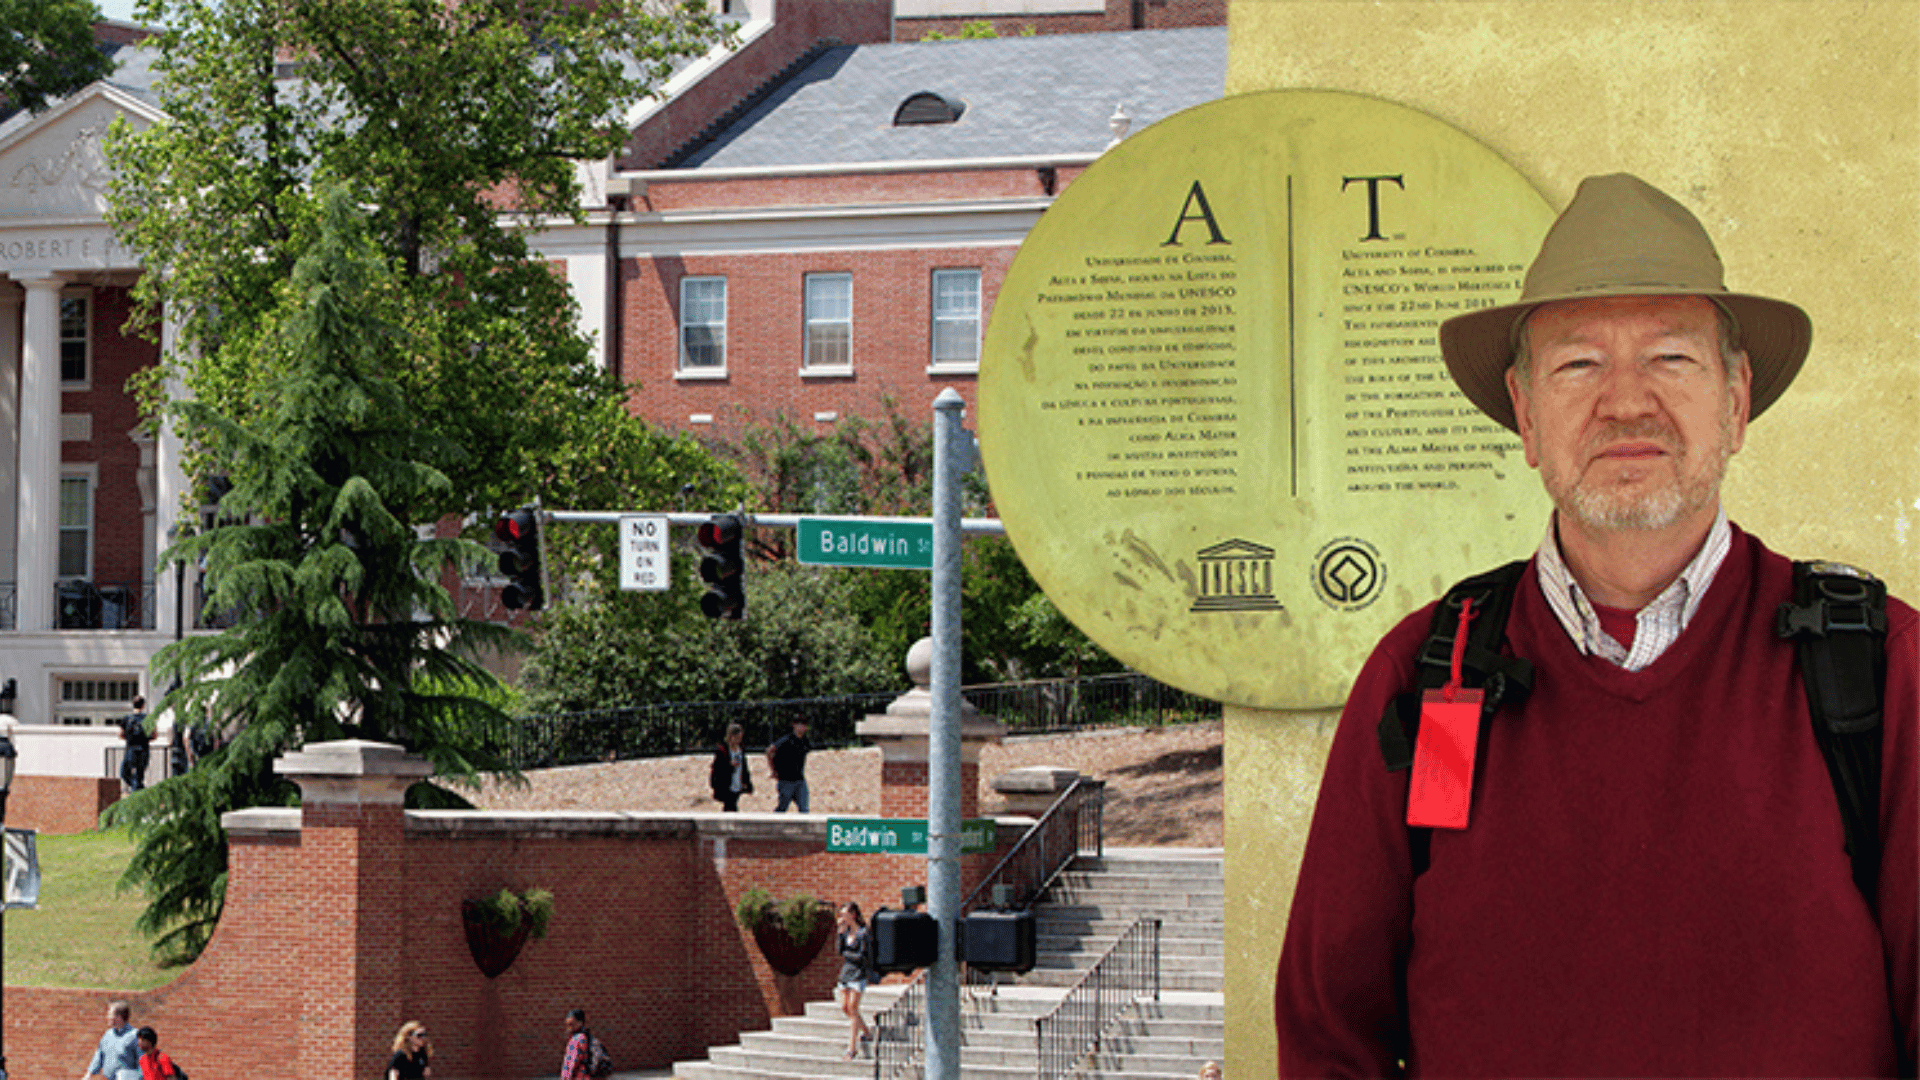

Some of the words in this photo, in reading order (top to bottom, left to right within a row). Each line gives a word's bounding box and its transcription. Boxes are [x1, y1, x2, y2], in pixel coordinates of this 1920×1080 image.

[1160, 179, 1232, 247] A
[1341, 173, 1405, 243] T
[1110, 308, 1125, 320] 22
[632, 522, 657, 538] NO
[630, 541, 660, 552] TURN
[820, 529, 909, 557] Baldwin
[635, 556, 654, 569] ON
[633, 572, 657, 586] RED
[831, 824, 898, 847] Baldwin
